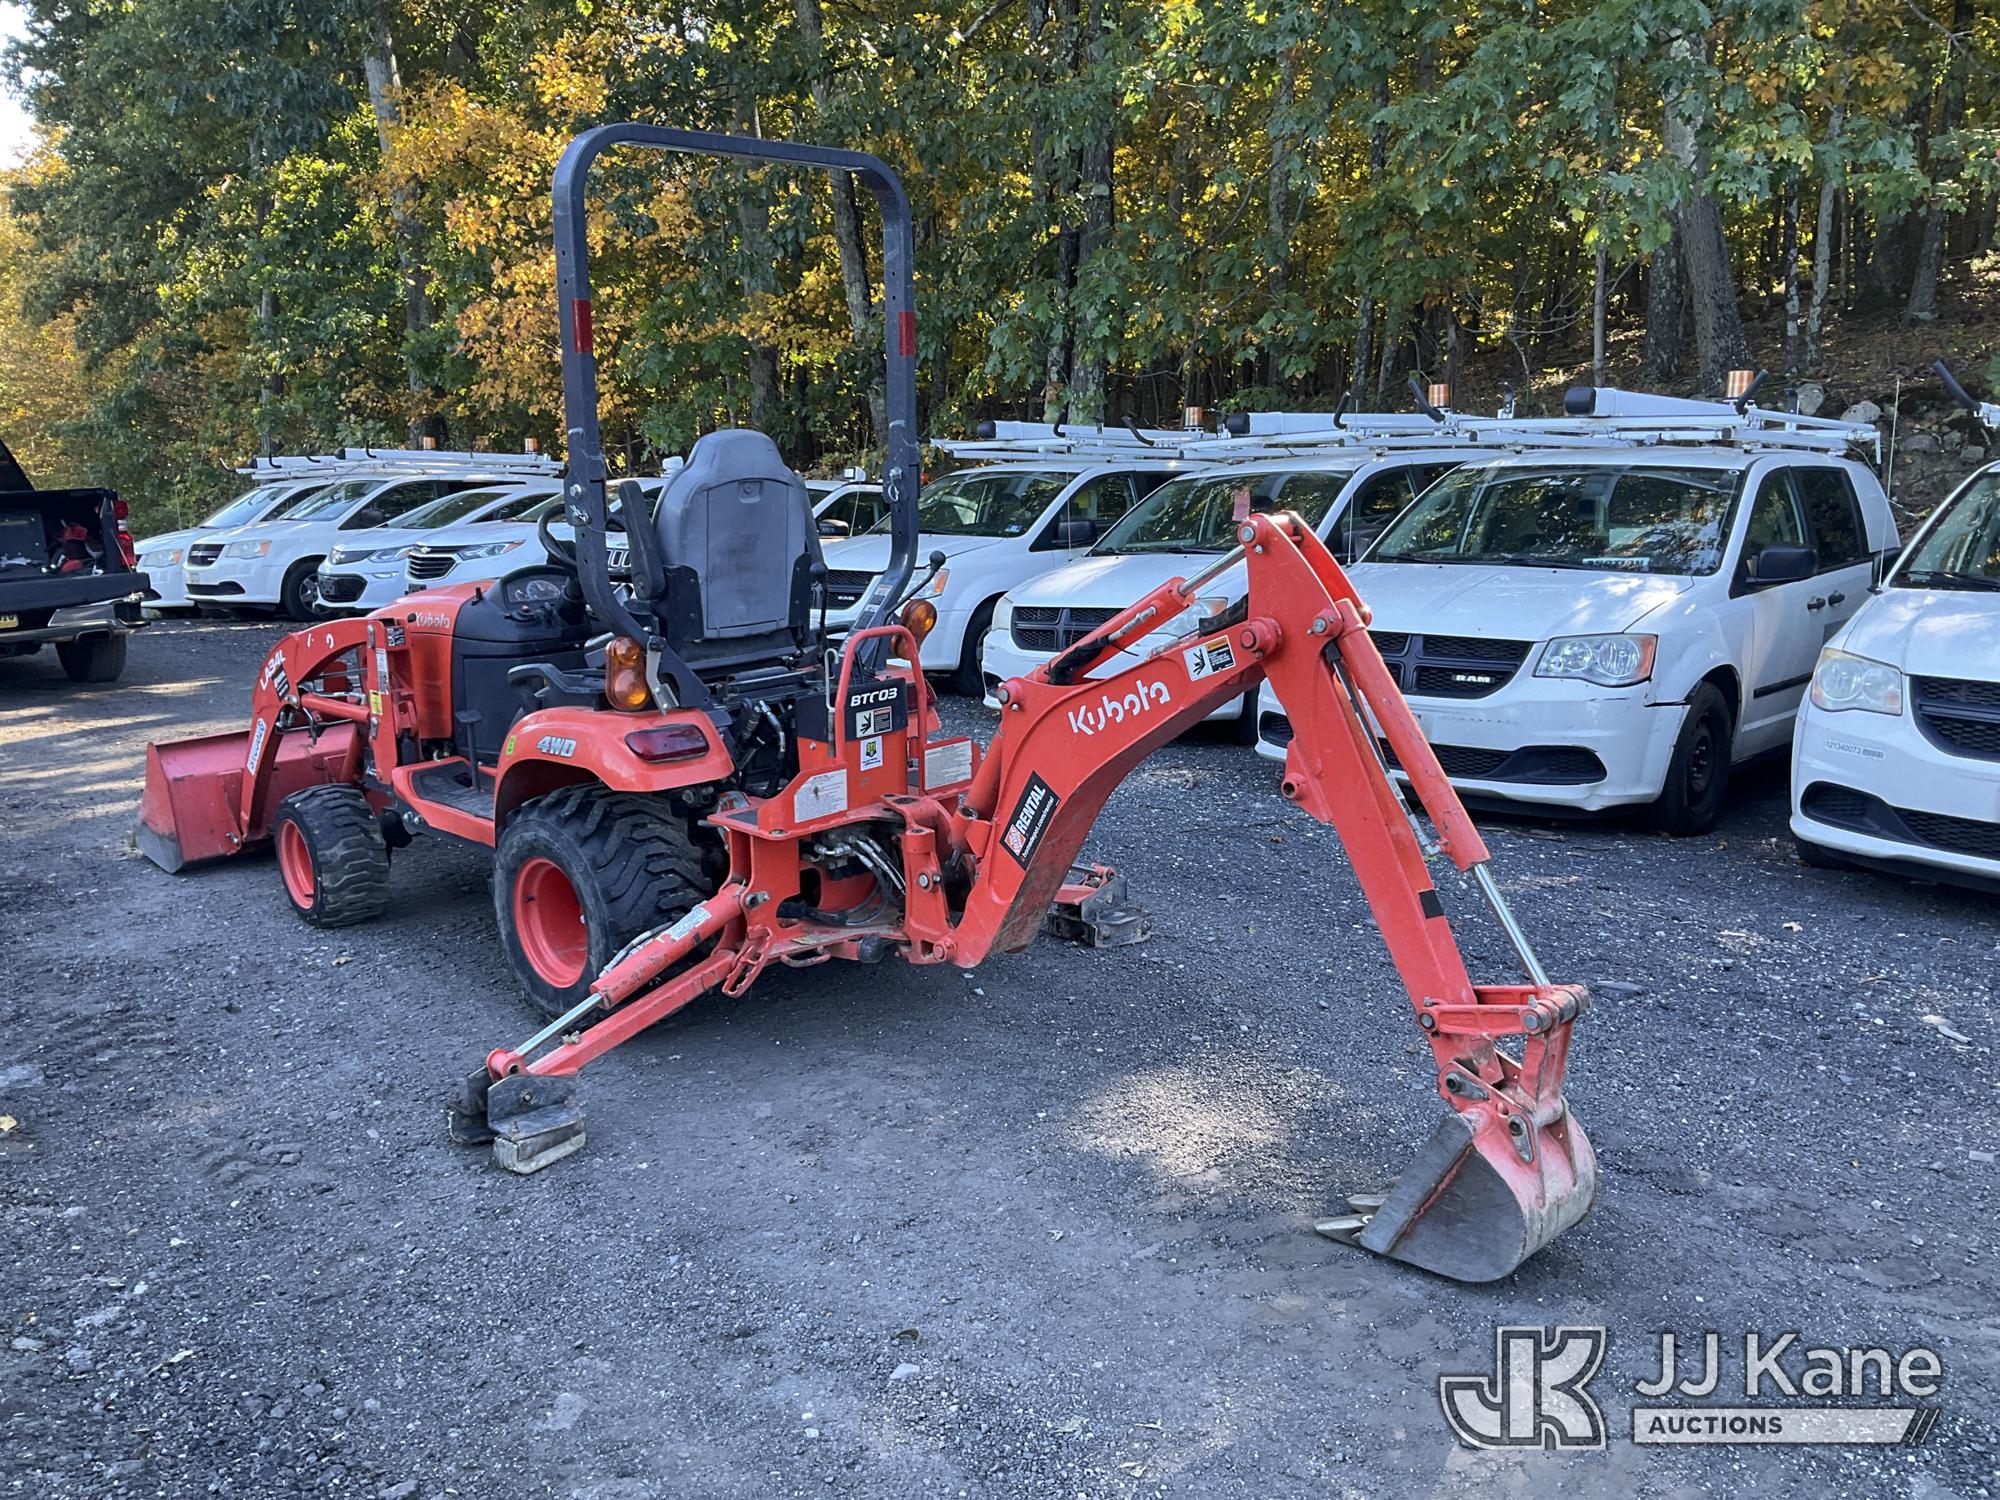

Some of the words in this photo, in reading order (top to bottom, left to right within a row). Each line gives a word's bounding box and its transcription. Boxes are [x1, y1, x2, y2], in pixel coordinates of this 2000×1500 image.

[415, 611, 450, 629] Kubota
[1456, 674, 1490, 683] RAM
[1068, 679, 1171, 736] Kubota
[536, 735, 576, 758] 4WD
[1015, 784, 1047, 835] RENTAL
[1022, 796, 1055, 858] homedepot.com/rental
